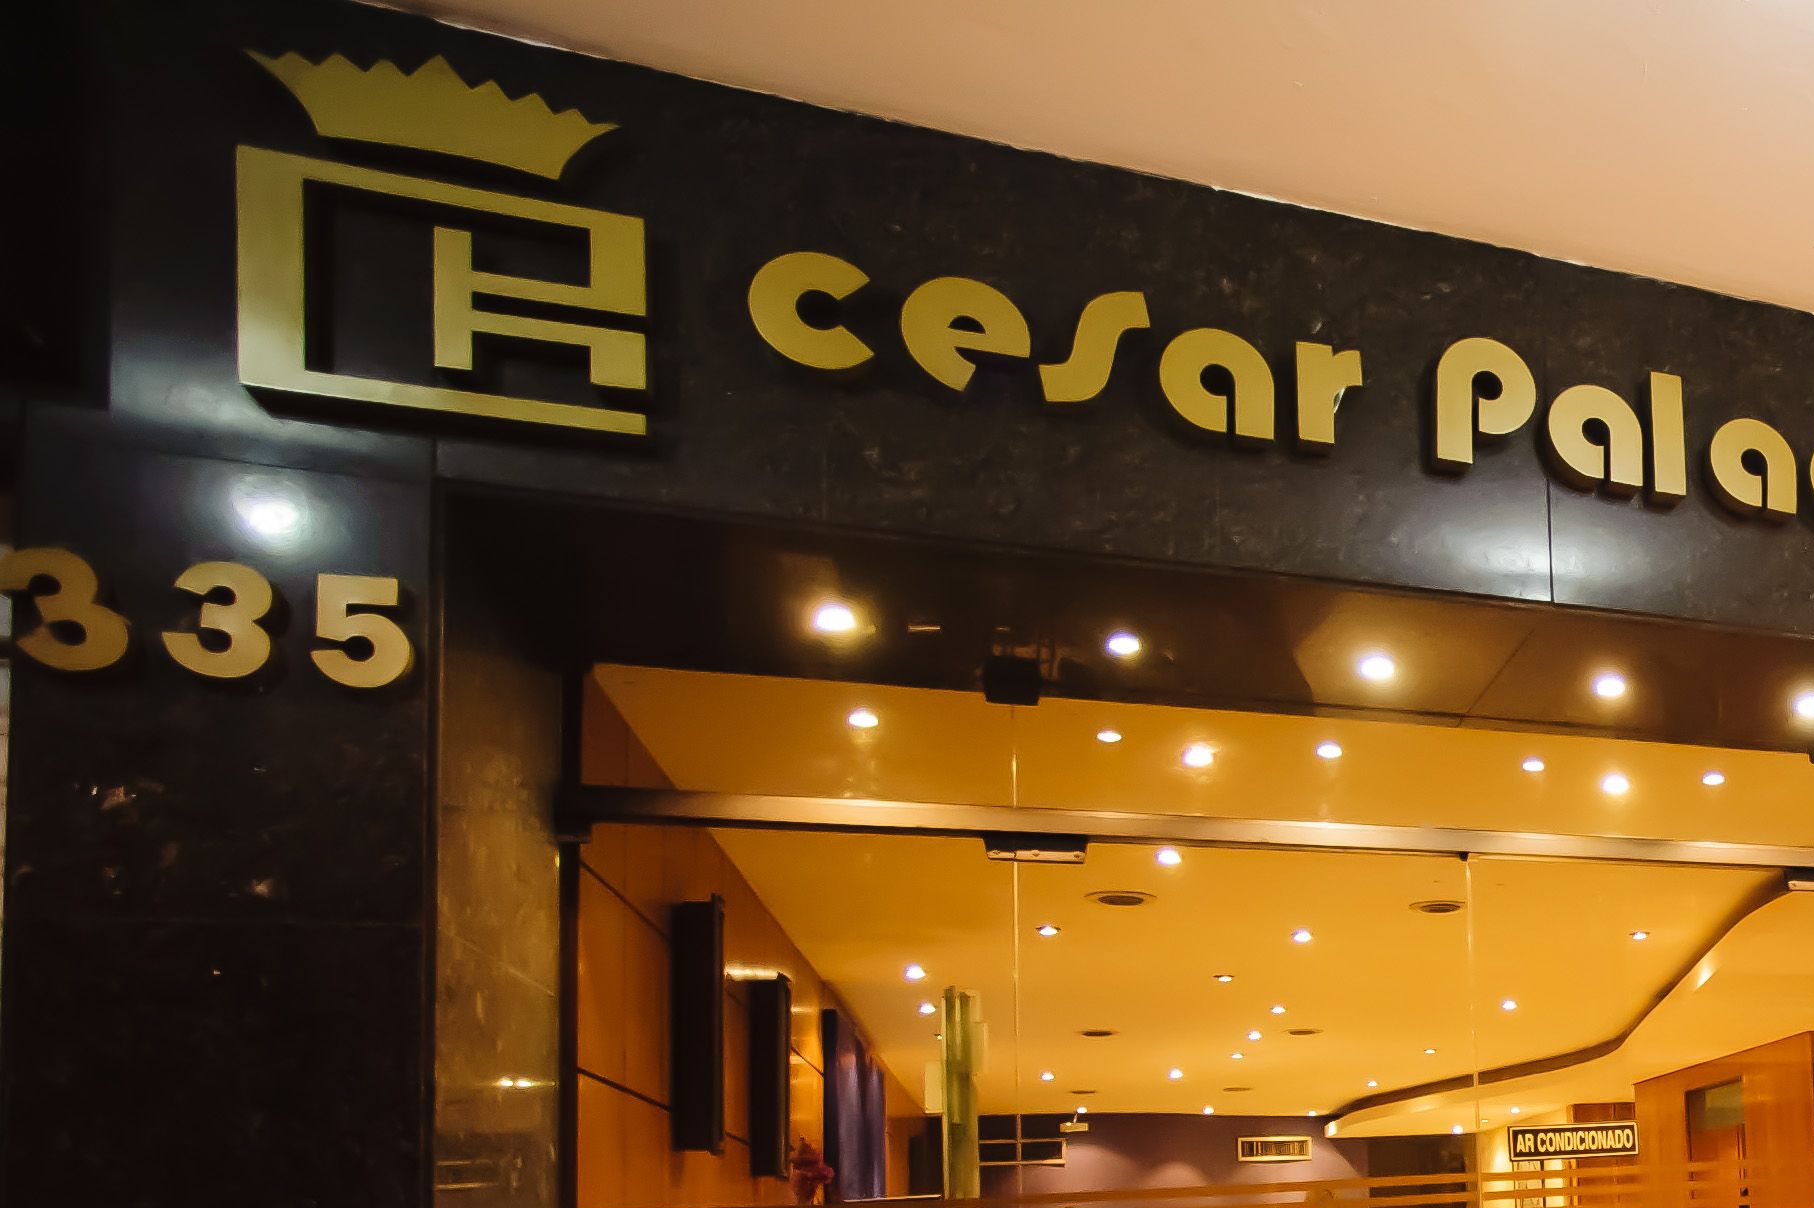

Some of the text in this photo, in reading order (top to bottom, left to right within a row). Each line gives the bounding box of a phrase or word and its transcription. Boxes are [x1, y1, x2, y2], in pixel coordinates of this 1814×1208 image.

[748, 251, 1362, 444] cesar
[0, 547, 412, 688] 335
[1517, 1129, 1633, 1152] AR CONDICIONADO
